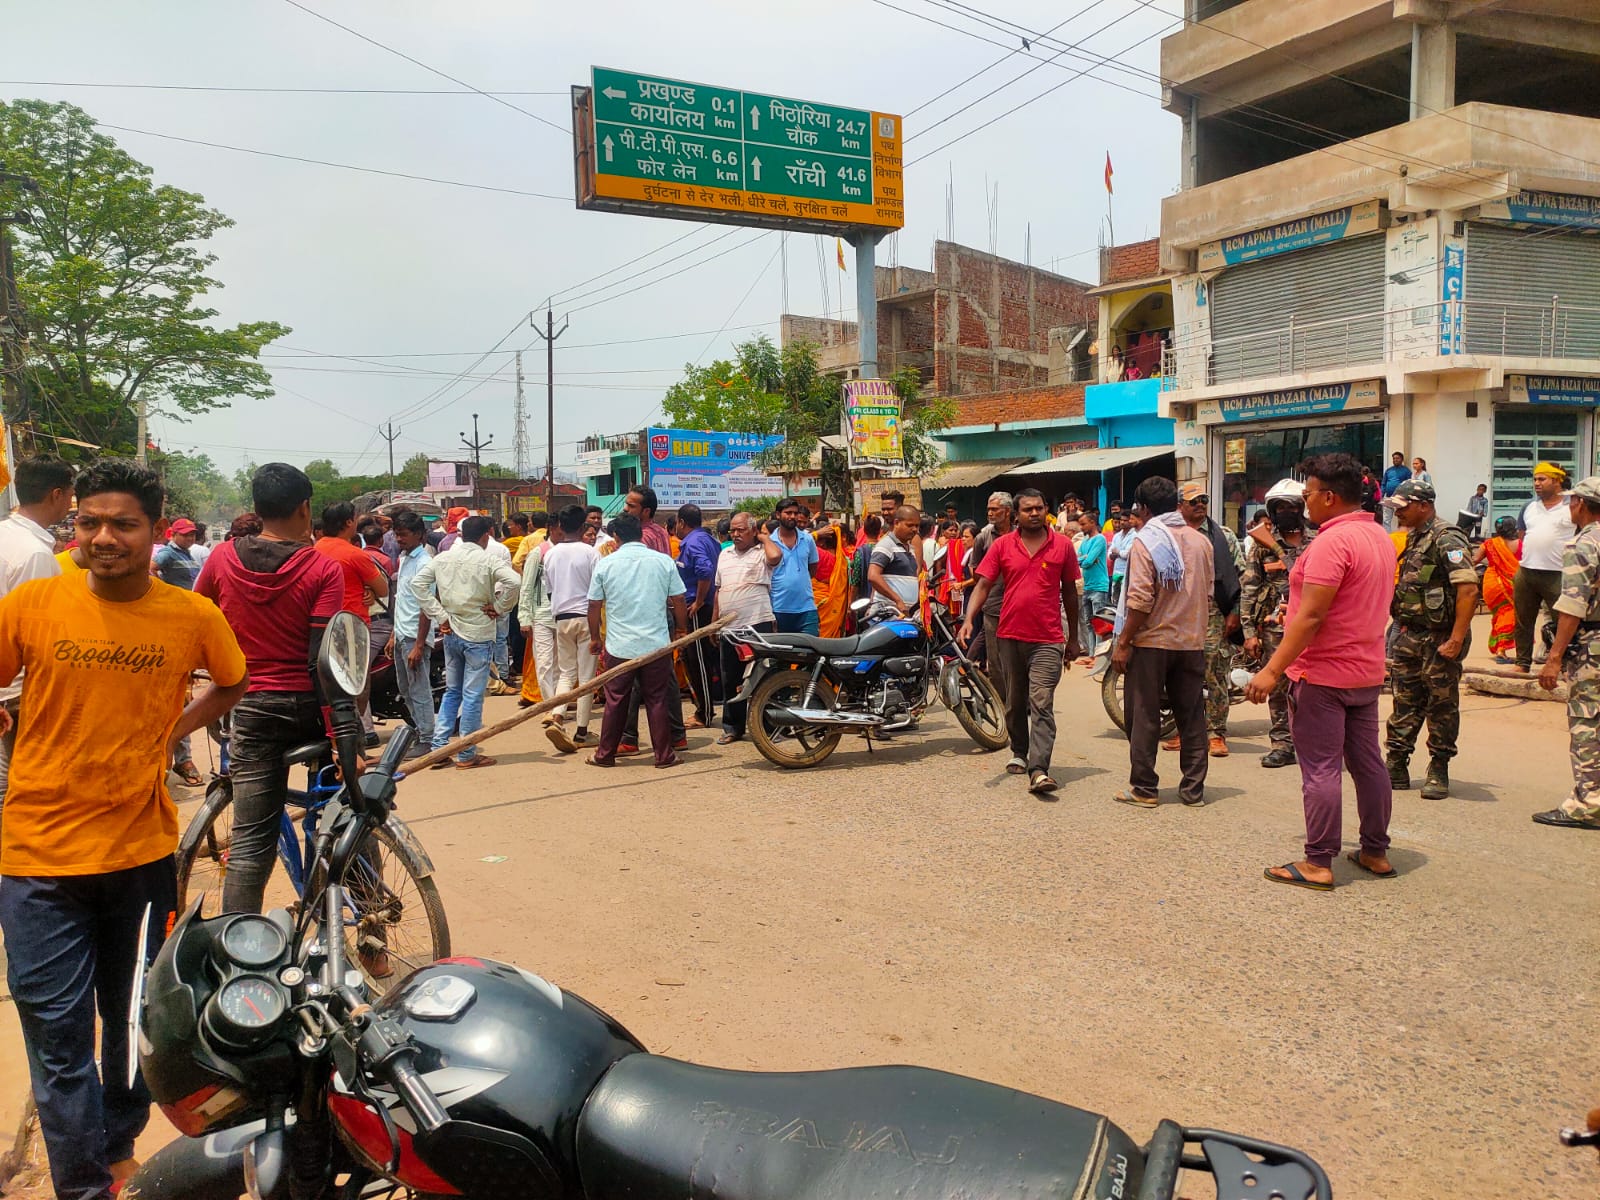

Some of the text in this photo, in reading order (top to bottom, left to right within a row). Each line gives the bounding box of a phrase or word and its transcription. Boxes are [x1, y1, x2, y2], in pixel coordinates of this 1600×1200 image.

[637, 79, 696, 105] प्रखण्ड
[711, 97, 735, 114] 0.1
[769, 99, 831, 129] पिठोरिया
[629, 102, 705, 130] कार्यालय
[714, 116, 736, 129] km
[785, 124, 819, 146] चौक
[836, 119, 867, 136] 24.7
[619, 128, 708, 160] पी.टी.पी.एस.
[841, 136, 861, 150] km
[712, 149, 738, 166] 6.6
[636, 156, 697, 181] फोर लेन
[716, 168, 739, 182] km
[837, 166, 867, 183] 41.6
[875, 165, 902, 180] विभाग
[642, 182, 681, 201] दुर्घटना
[685, 187, 695, 201] से
[699, 188, 714, 203] देर
[747, 194, 766, 209] धीरे
[793, 200, 828, 217] सुरक्षित
[842, 183, 861, 196] km
[1532, 191, 1557, 209] APNA
[1559, 196, 1588, 211] BAZAR
[1226, 237, 1245, 253] RCM
[1247, 229, 1273, 247] APNA
[1274, 220, 1308, 239] BAZAR
[1310, 208, 1346, 232] (MALL)
[1224, 399, 1243, 412] RCM
[1245, 395, 1271, 409] APNA
[1273, 391, 1307, 406] BAZAR
[1309, 384, 1346, 403] (MALL)
[1356, 390, 1376, 398] RCM
[672, 440, 710, 457] RKDF
[53, 639, 166, 674] Brooklyn
[1111, 1153, 1128, 1199] BAJAJ
